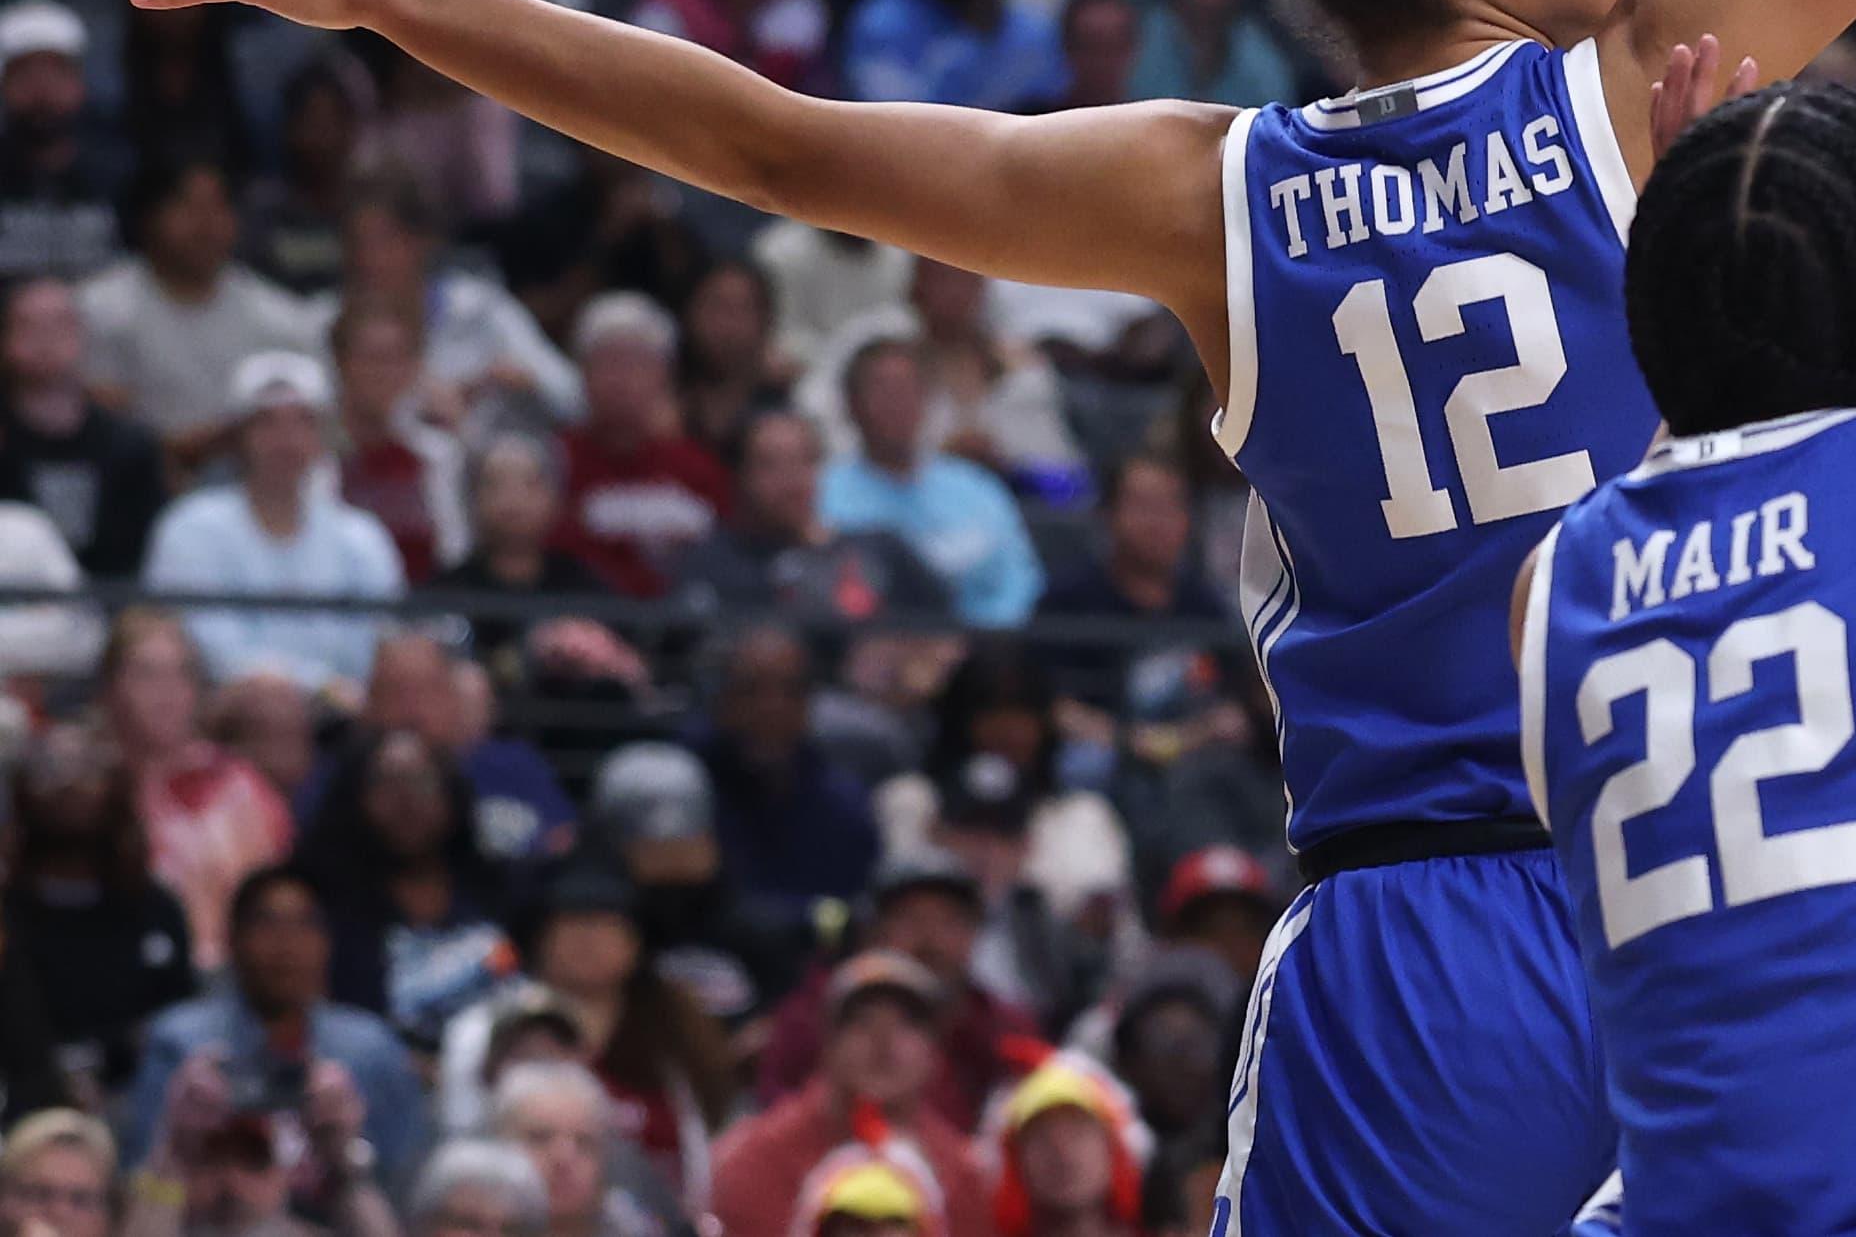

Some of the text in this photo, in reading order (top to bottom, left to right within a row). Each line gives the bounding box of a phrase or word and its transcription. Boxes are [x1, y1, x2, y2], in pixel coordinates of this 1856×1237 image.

[1269, 114, 1575, 259] THOMAS
[1331, 251, 1598, 540] 12
[1609, 490, 1816, 623] MAIR
